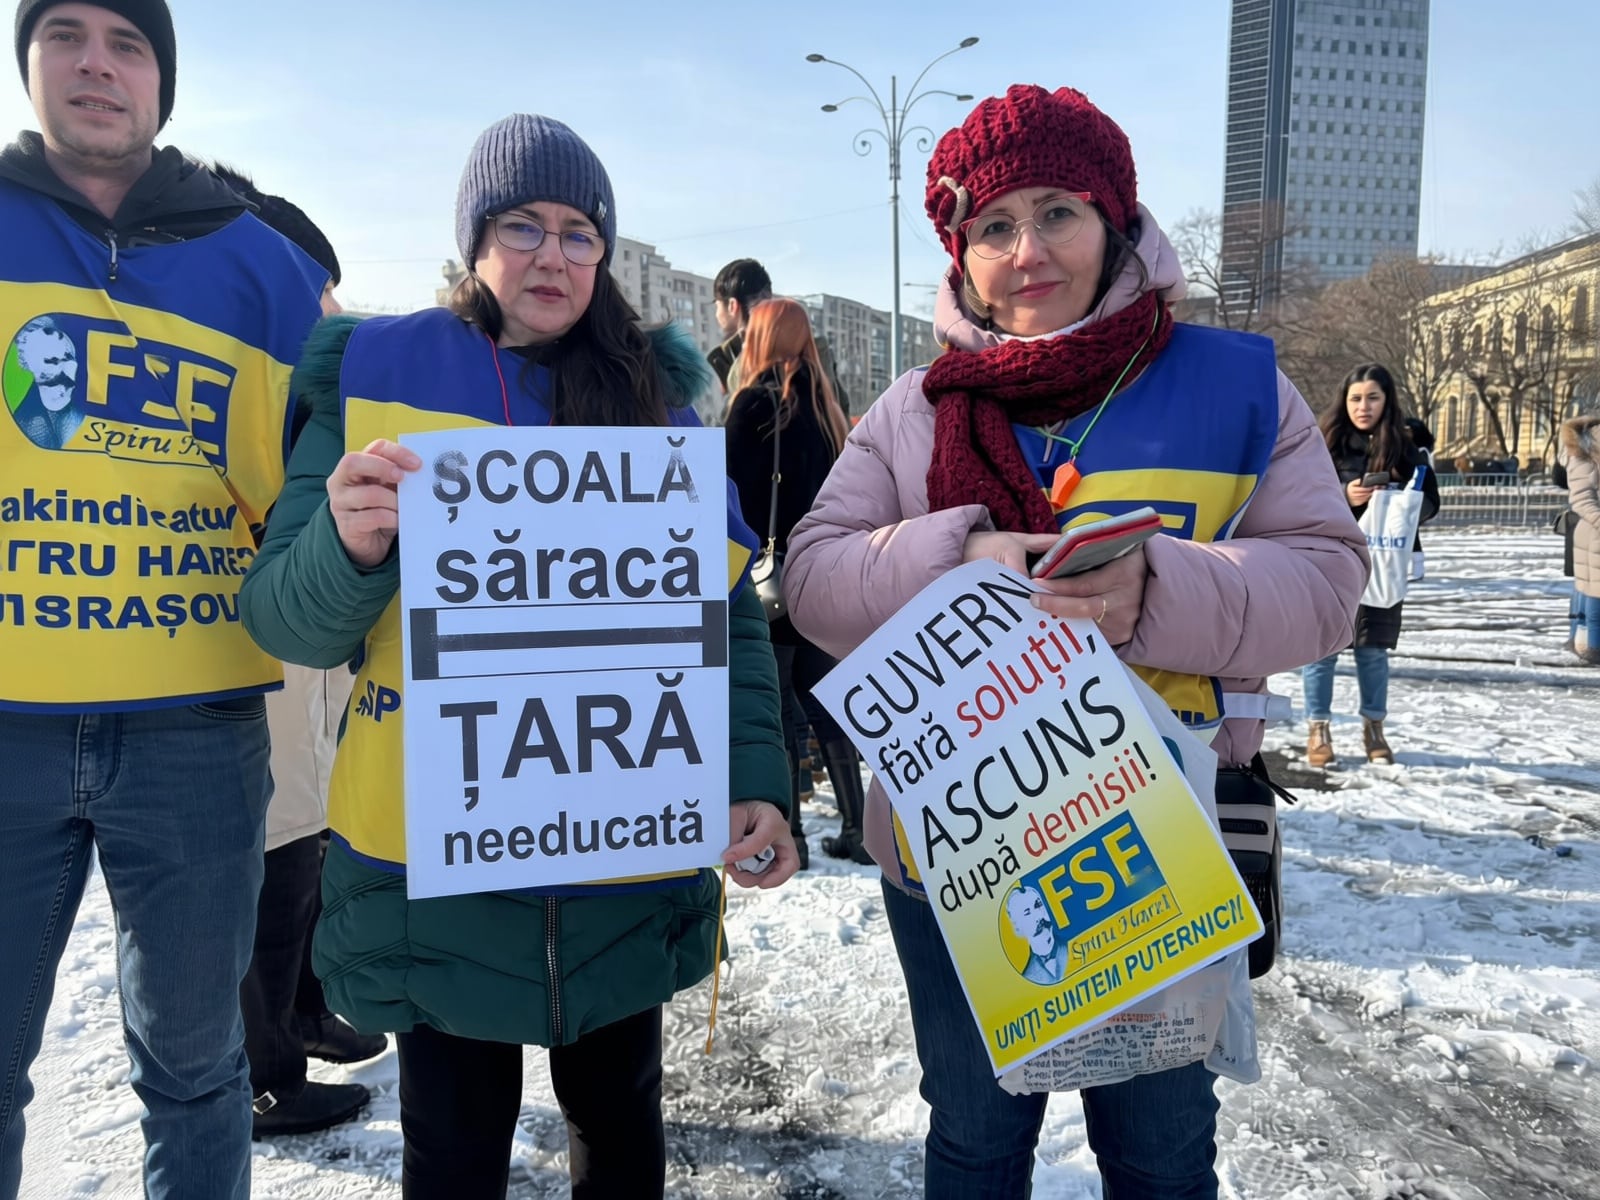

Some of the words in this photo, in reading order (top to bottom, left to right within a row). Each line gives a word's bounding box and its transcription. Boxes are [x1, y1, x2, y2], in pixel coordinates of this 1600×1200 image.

[84, 421, 170, 454] Spiru
[432, 436, 700, 524] ȘCOALĂ
[435, 528, 702, 604] săracă
[844, 572, 1036, 739] GUVERN
[439, 672, 704, 812] ȚARĂ
[878, 711, 958, 795] fără
[921, 675, 1126, 870] ASCUNS
[443, 798, 705, 867] needucată
[939, 833, 1022, 913] după
[1022, 740, 1158, 858] demisii!
